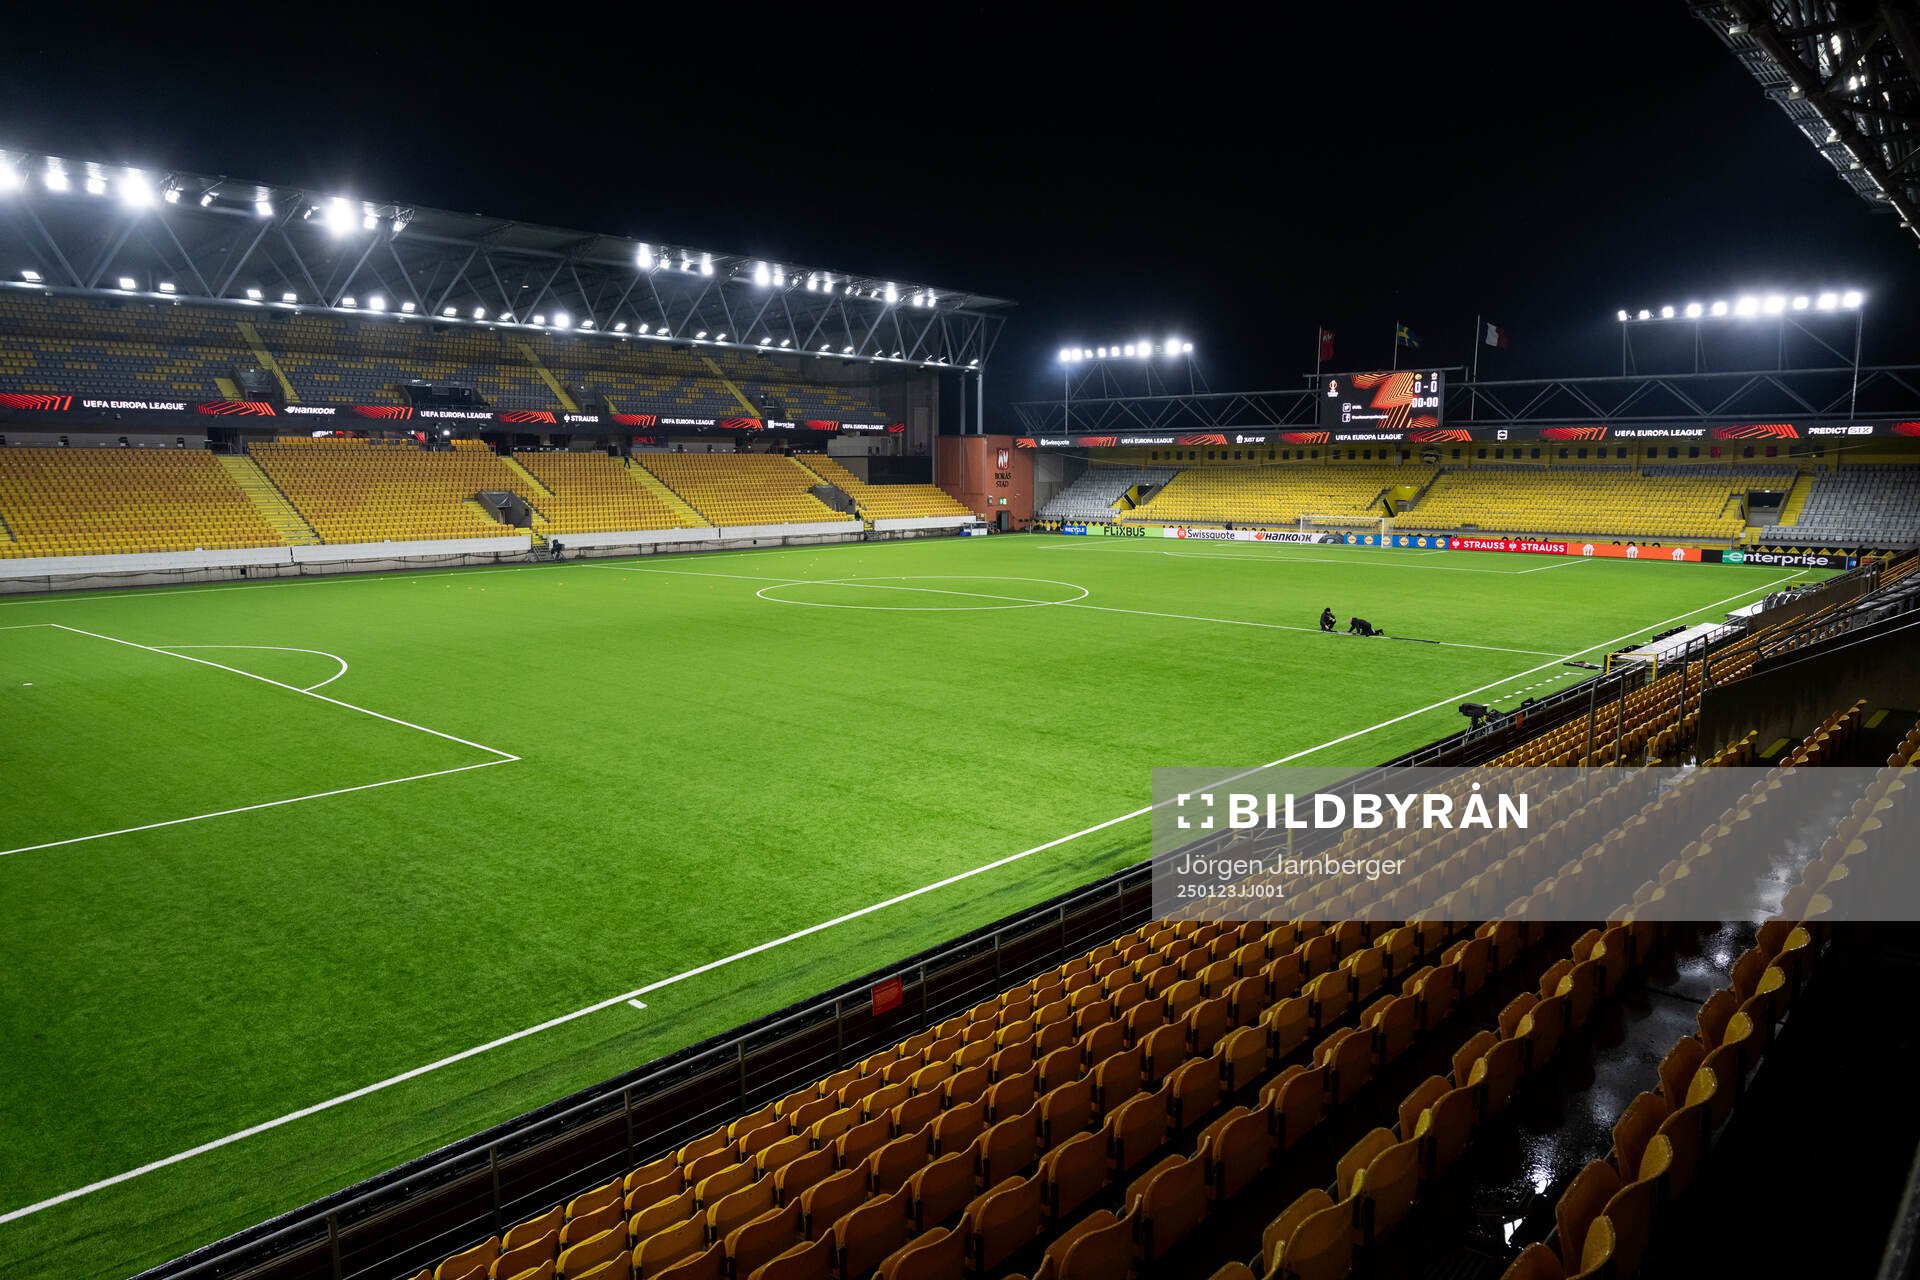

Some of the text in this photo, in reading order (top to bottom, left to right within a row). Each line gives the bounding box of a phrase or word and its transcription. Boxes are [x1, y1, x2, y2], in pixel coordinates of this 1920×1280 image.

[1415, 381, 1421, 393] 0
[1431, 381, 1437, 392] 0
[83, 400, 185, 410] UEFA EUROPA LEAGUE
[420, 410, 439, 418] UEFA
[439, 411, 466, 419] EUROPA
[571, 415, 599, 423] STRAUSS
[1637, 429, 1669, 437] EUROPA
[1808, 427, 1847, 435] PREDICT
[1335, 433, 1351, 441] UEFA
[1352, 433, 1376, 441] EUROPA
[1187, 529, 1235, 540] Swissquote
[1463, 540, 1505, 550] STRAUSS
[1521, 543, 1565, 552] STRAUSS
[1725, 552, 1829, 566] enterprise
